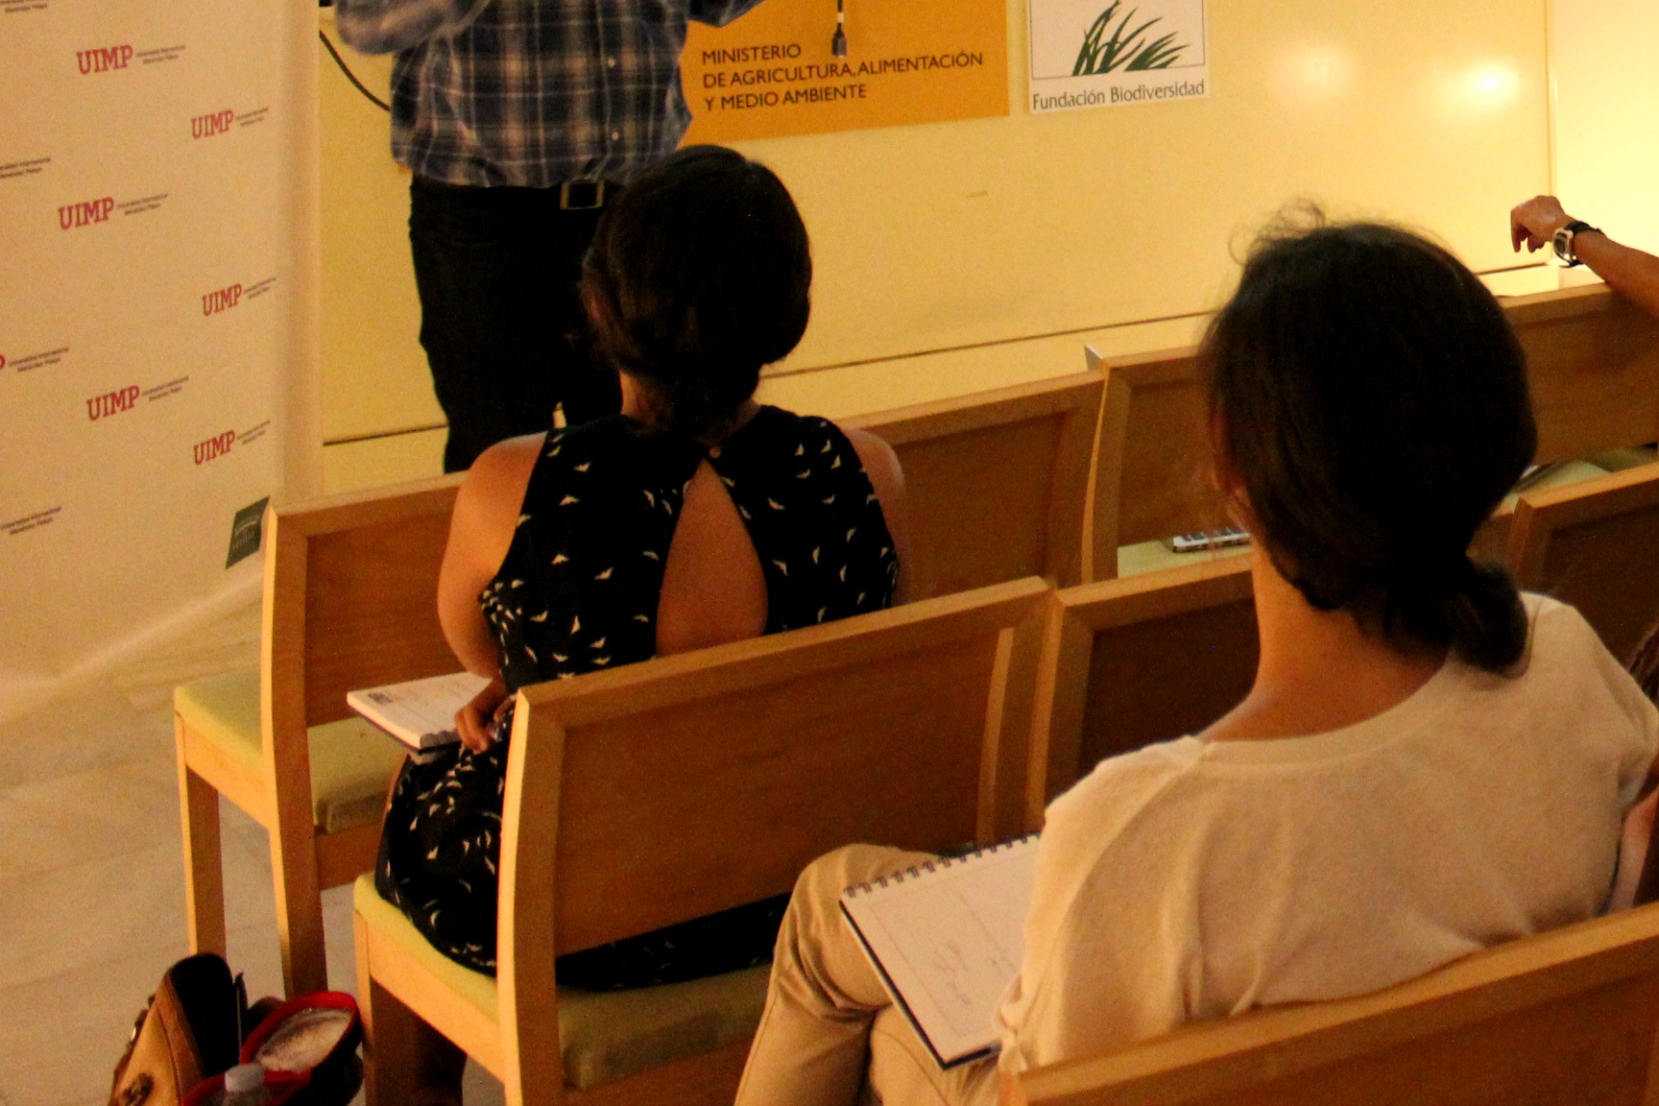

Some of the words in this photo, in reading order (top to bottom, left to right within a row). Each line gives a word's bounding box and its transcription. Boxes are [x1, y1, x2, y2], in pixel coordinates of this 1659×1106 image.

[76, 44, 133, 75] UIMP
[702, 44, 802, 65] MINISTERIO
[703, 71, 727, 89] DE
[730, 65, 857, 86] AGRICULTURA,
[859, 51, 984, 75] ALIMENTACIÓN
[704, 97, 716, 112] Y
[721, 92, 779, 110] MEDIO
[782, 84, 867, 106] AMBIENTE
[1032, 89, 1106, 110] Fundación
[1110, 79, 1205, 104] Biodiversidad
[191, 109, 234, 140] UIMP
[58, 197, 115, 230] UIMP
[202, 283, 242, 317] UIMP
[87, 385, 140, 421] UIMP
[193, 430, 235, 465] UIMP
